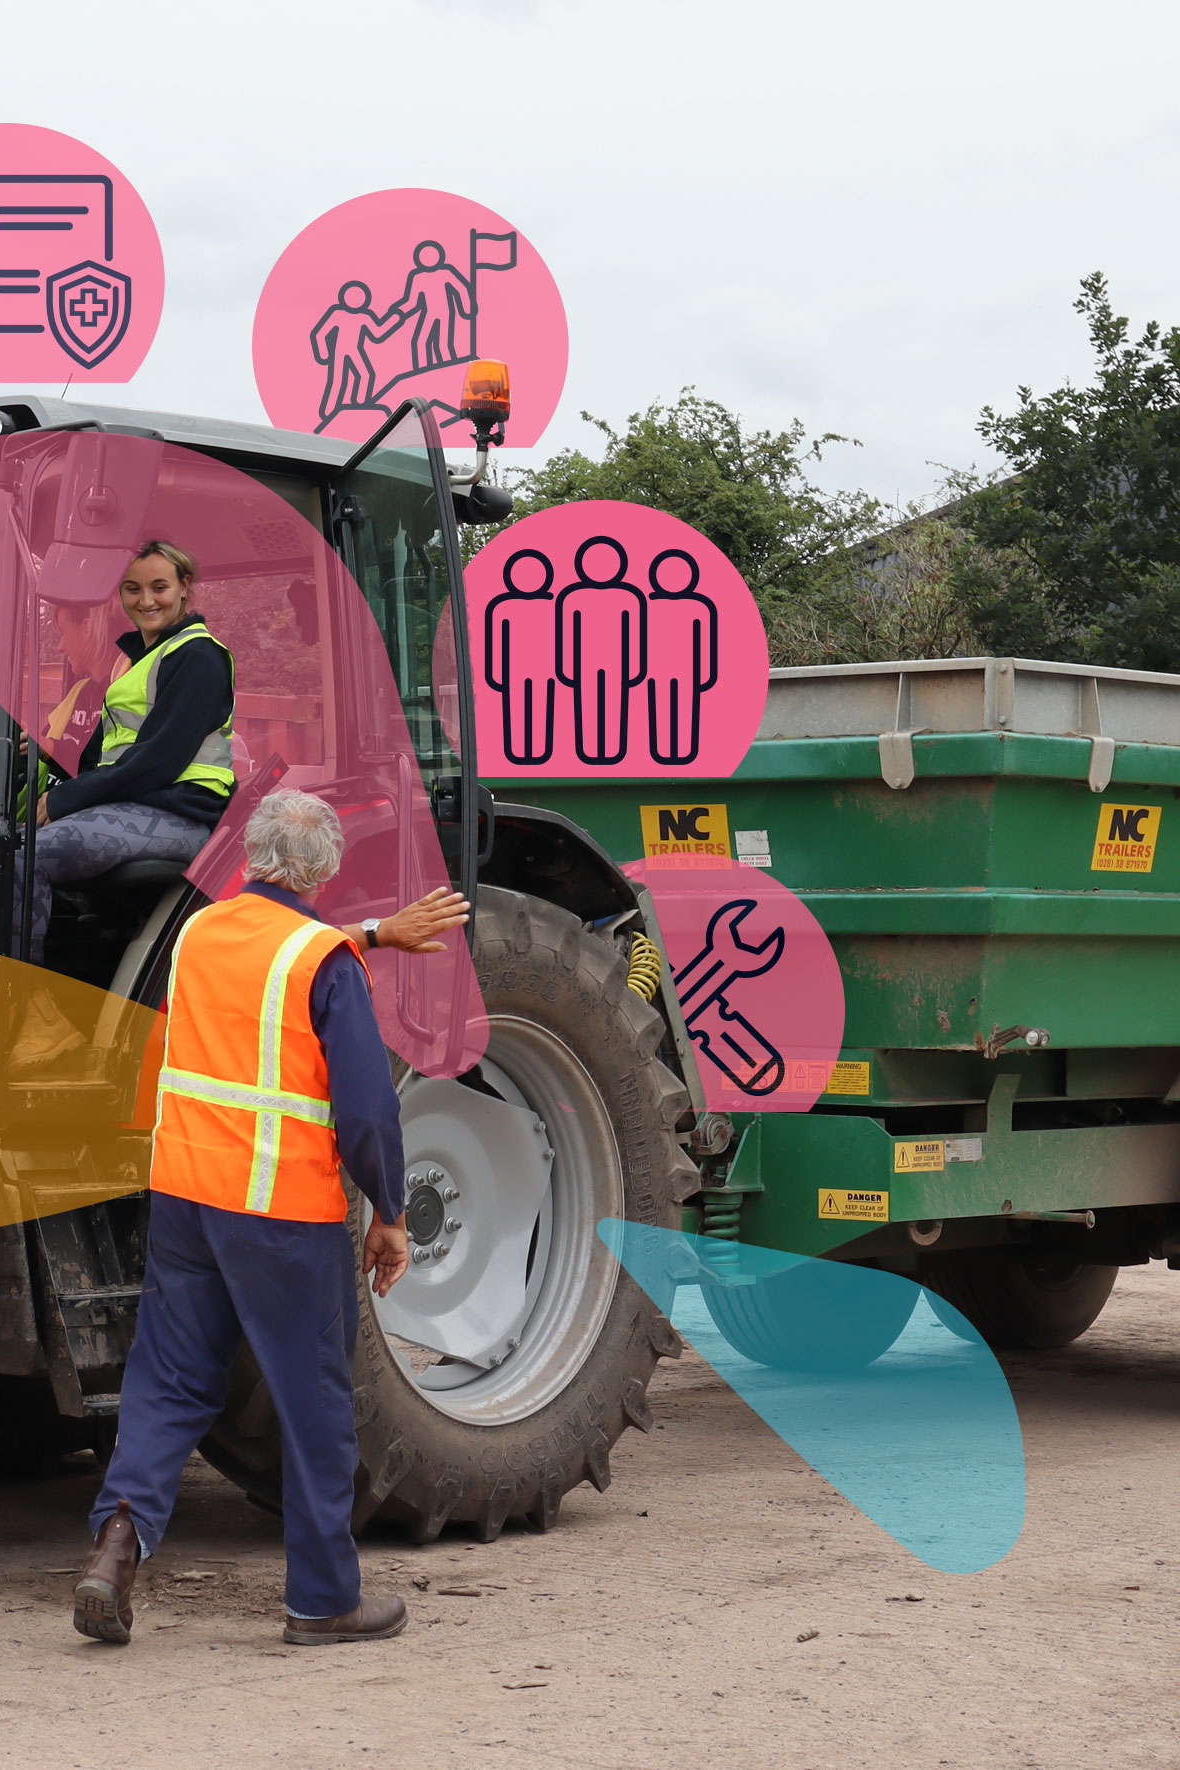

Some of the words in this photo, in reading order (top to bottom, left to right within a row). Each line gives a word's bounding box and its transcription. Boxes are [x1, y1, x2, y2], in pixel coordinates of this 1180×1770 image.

[658, 807, 710, 841] NC
[1108, 808, 1150, 842] NC
[648, 842, 726, 856] TRAILERS
[1098, 843, 1151, 858] TRAILERS
[915, 1144, 940, 1152] DANGER
[847, 1193, 882, 1202] DANGER
